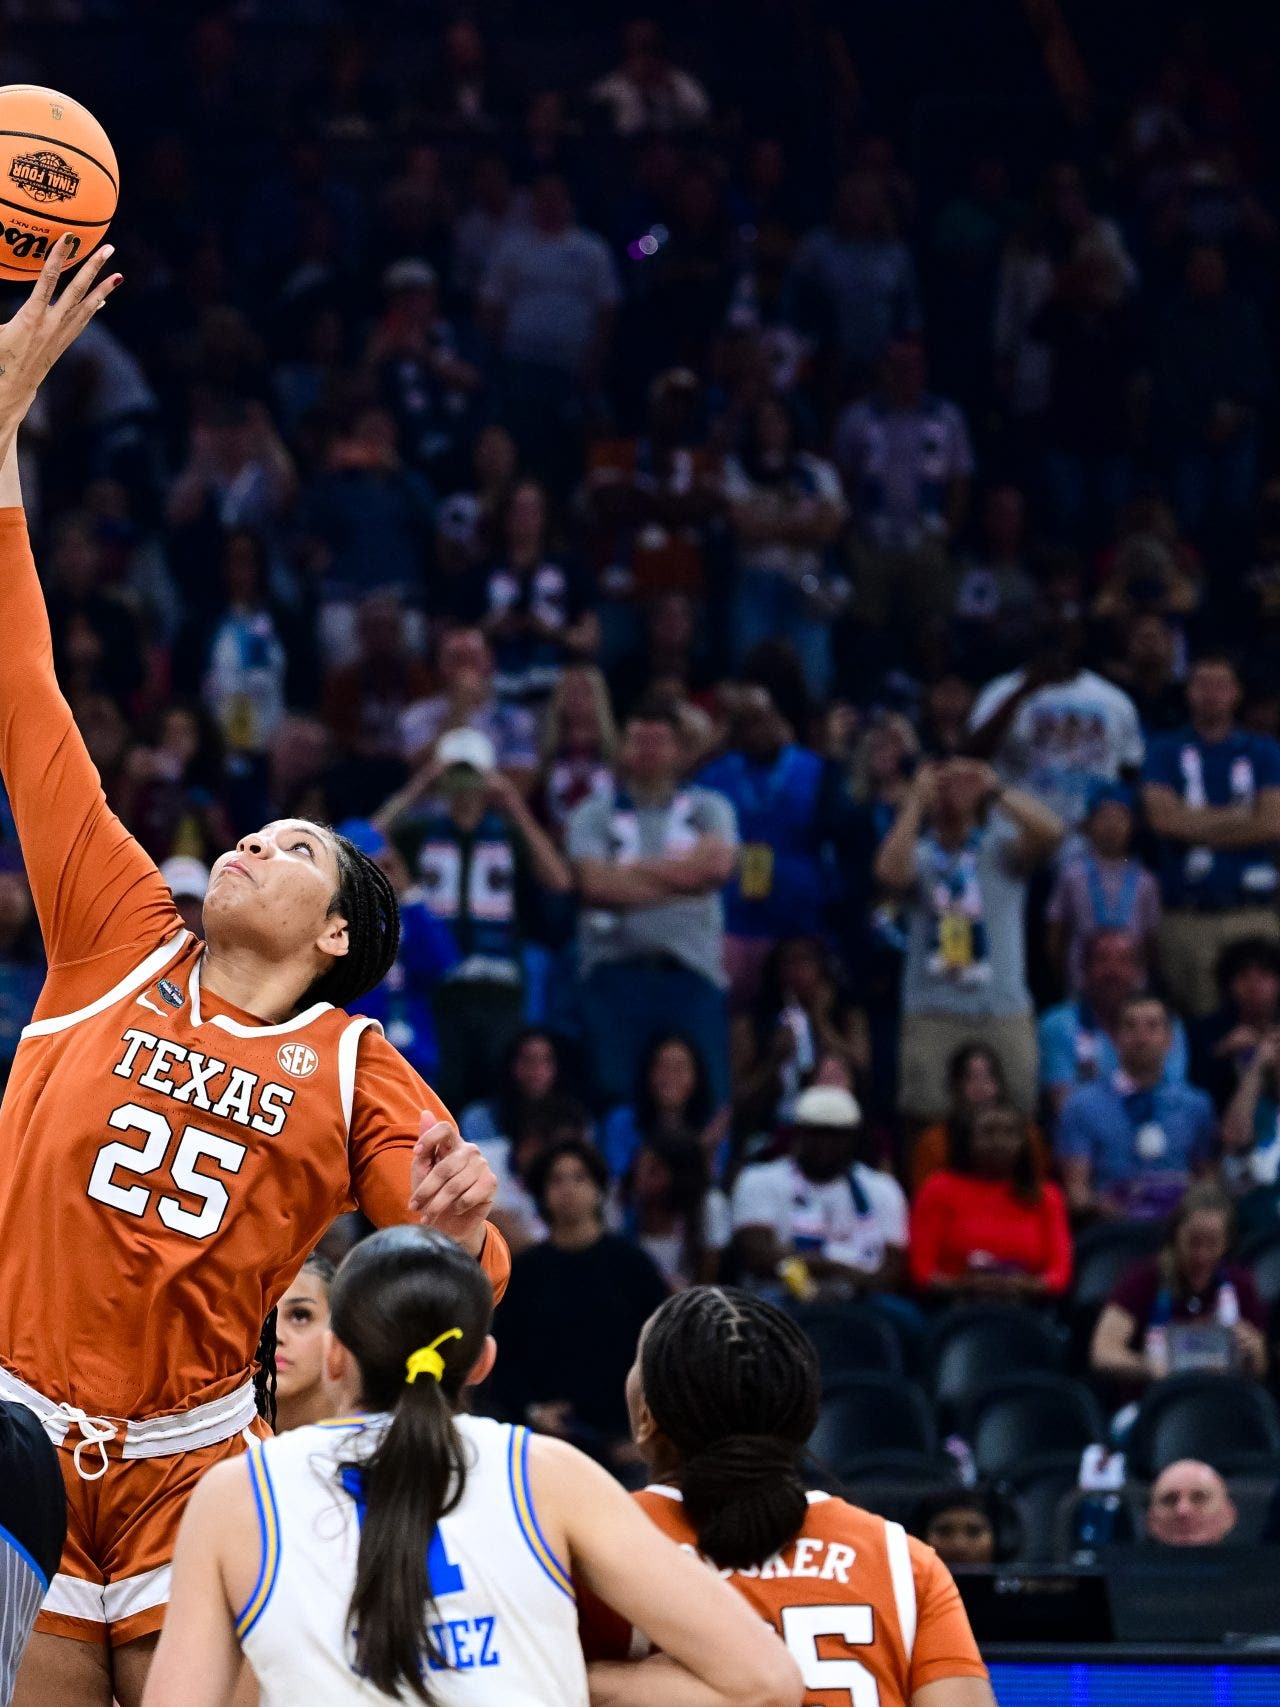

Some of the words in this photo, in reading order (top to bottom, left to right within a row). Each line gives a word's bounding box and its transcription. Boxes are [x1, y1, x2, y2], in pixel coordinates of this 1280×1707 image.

[12, 163, 45, 183] FOUR
[47, 172, 77, 194] FINAL
[10, 218, 29, 229] NXT
[31, 225, 50, 233] EVO
[280, 1044, 317, 1076] SEC
[113, 1028, 296, 1137] TEXAS
[86, 1102, 248, 1240] 25
[680, 1538, 856, 1583] KER
[766, 1604, 880, 1707] 5
